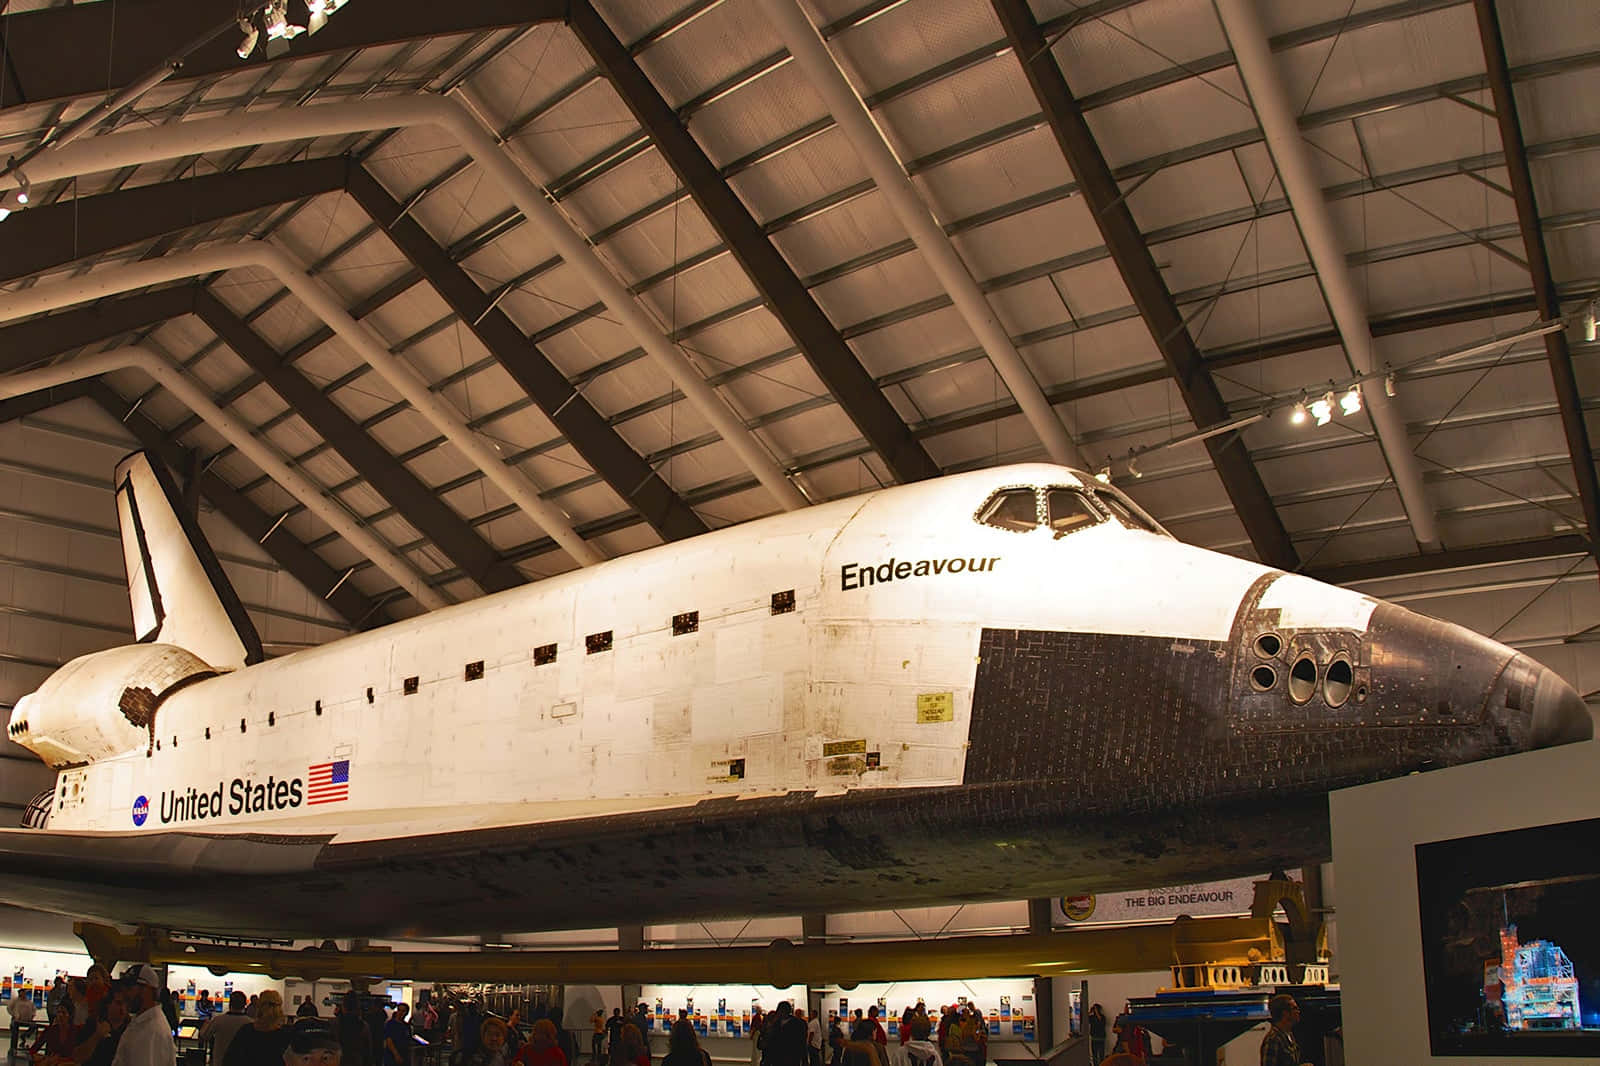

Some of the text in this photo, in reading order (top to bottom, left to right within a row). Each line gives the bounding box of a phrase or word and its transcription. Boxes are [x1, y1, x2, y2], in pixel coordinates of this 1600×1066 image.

[841, 558, 1001, 591] Endeavour
[132, 807, 149, 815] NASA
[160, 776, 303, 823] United States
[1125, 891, 1233, 907] THE BIG ENDEAVOUR
